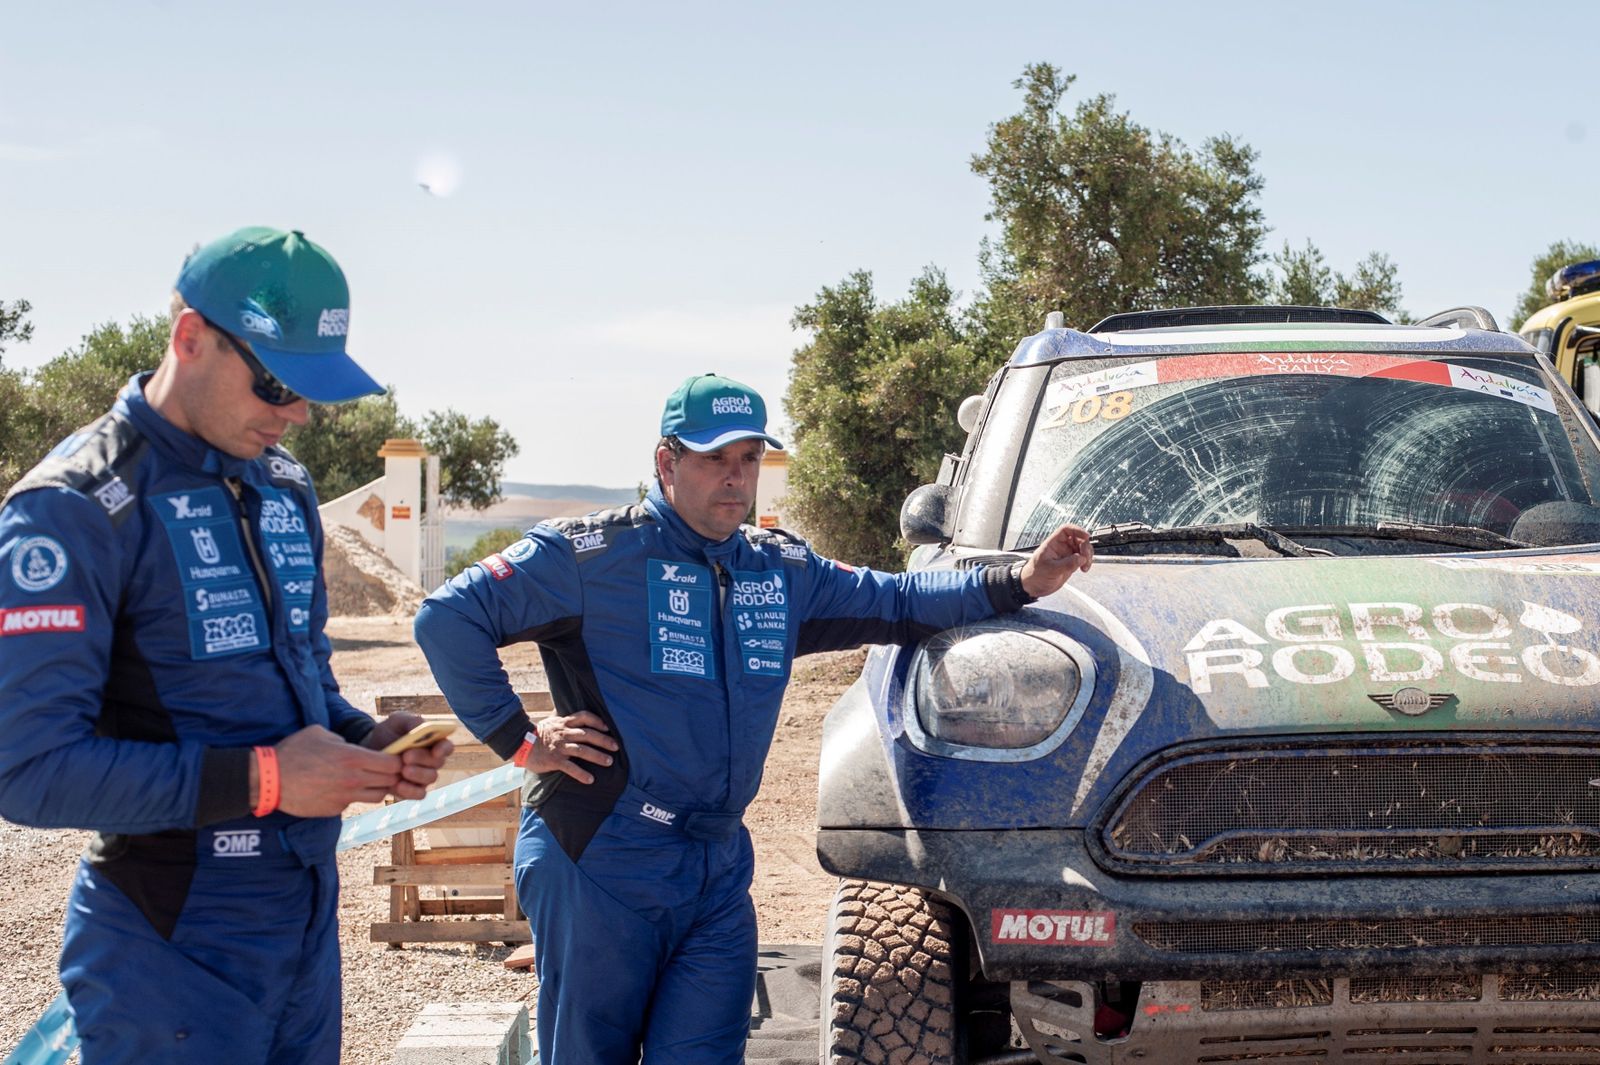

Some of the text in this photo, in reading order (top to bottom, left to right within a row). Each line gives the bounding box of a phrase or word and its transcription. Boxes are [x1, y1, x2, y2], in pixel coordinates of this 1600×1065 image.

[1257, 353, 1353, 367] Andalucía
[1278, 365, 1334, 374] RALLY
[1460, 367, 1545, 401] Andalucía
[712, 396, 745, 406] AGRO
[712, 404, 753, 415] RODEO
[1040, 391, 1135, 430] 208
[97, 479, 132, 511] OMP
[572, 533, 606, 551] OMP
[733, 592, 785, 606] RODEO
[3, 610, 80, 631] MOTUL
[657, 612, 702, 628] Husqvarna
[1182, 602, 1512, 651] AGRO
[668, 631, 705, 644] BUNASTA
[1187, 642, 1600, 694] RODEO
[641, 802, 677, 824] OMP
[213, 832, 261, 855] OMP
[998, 915, 1110, 942] MOTUL
